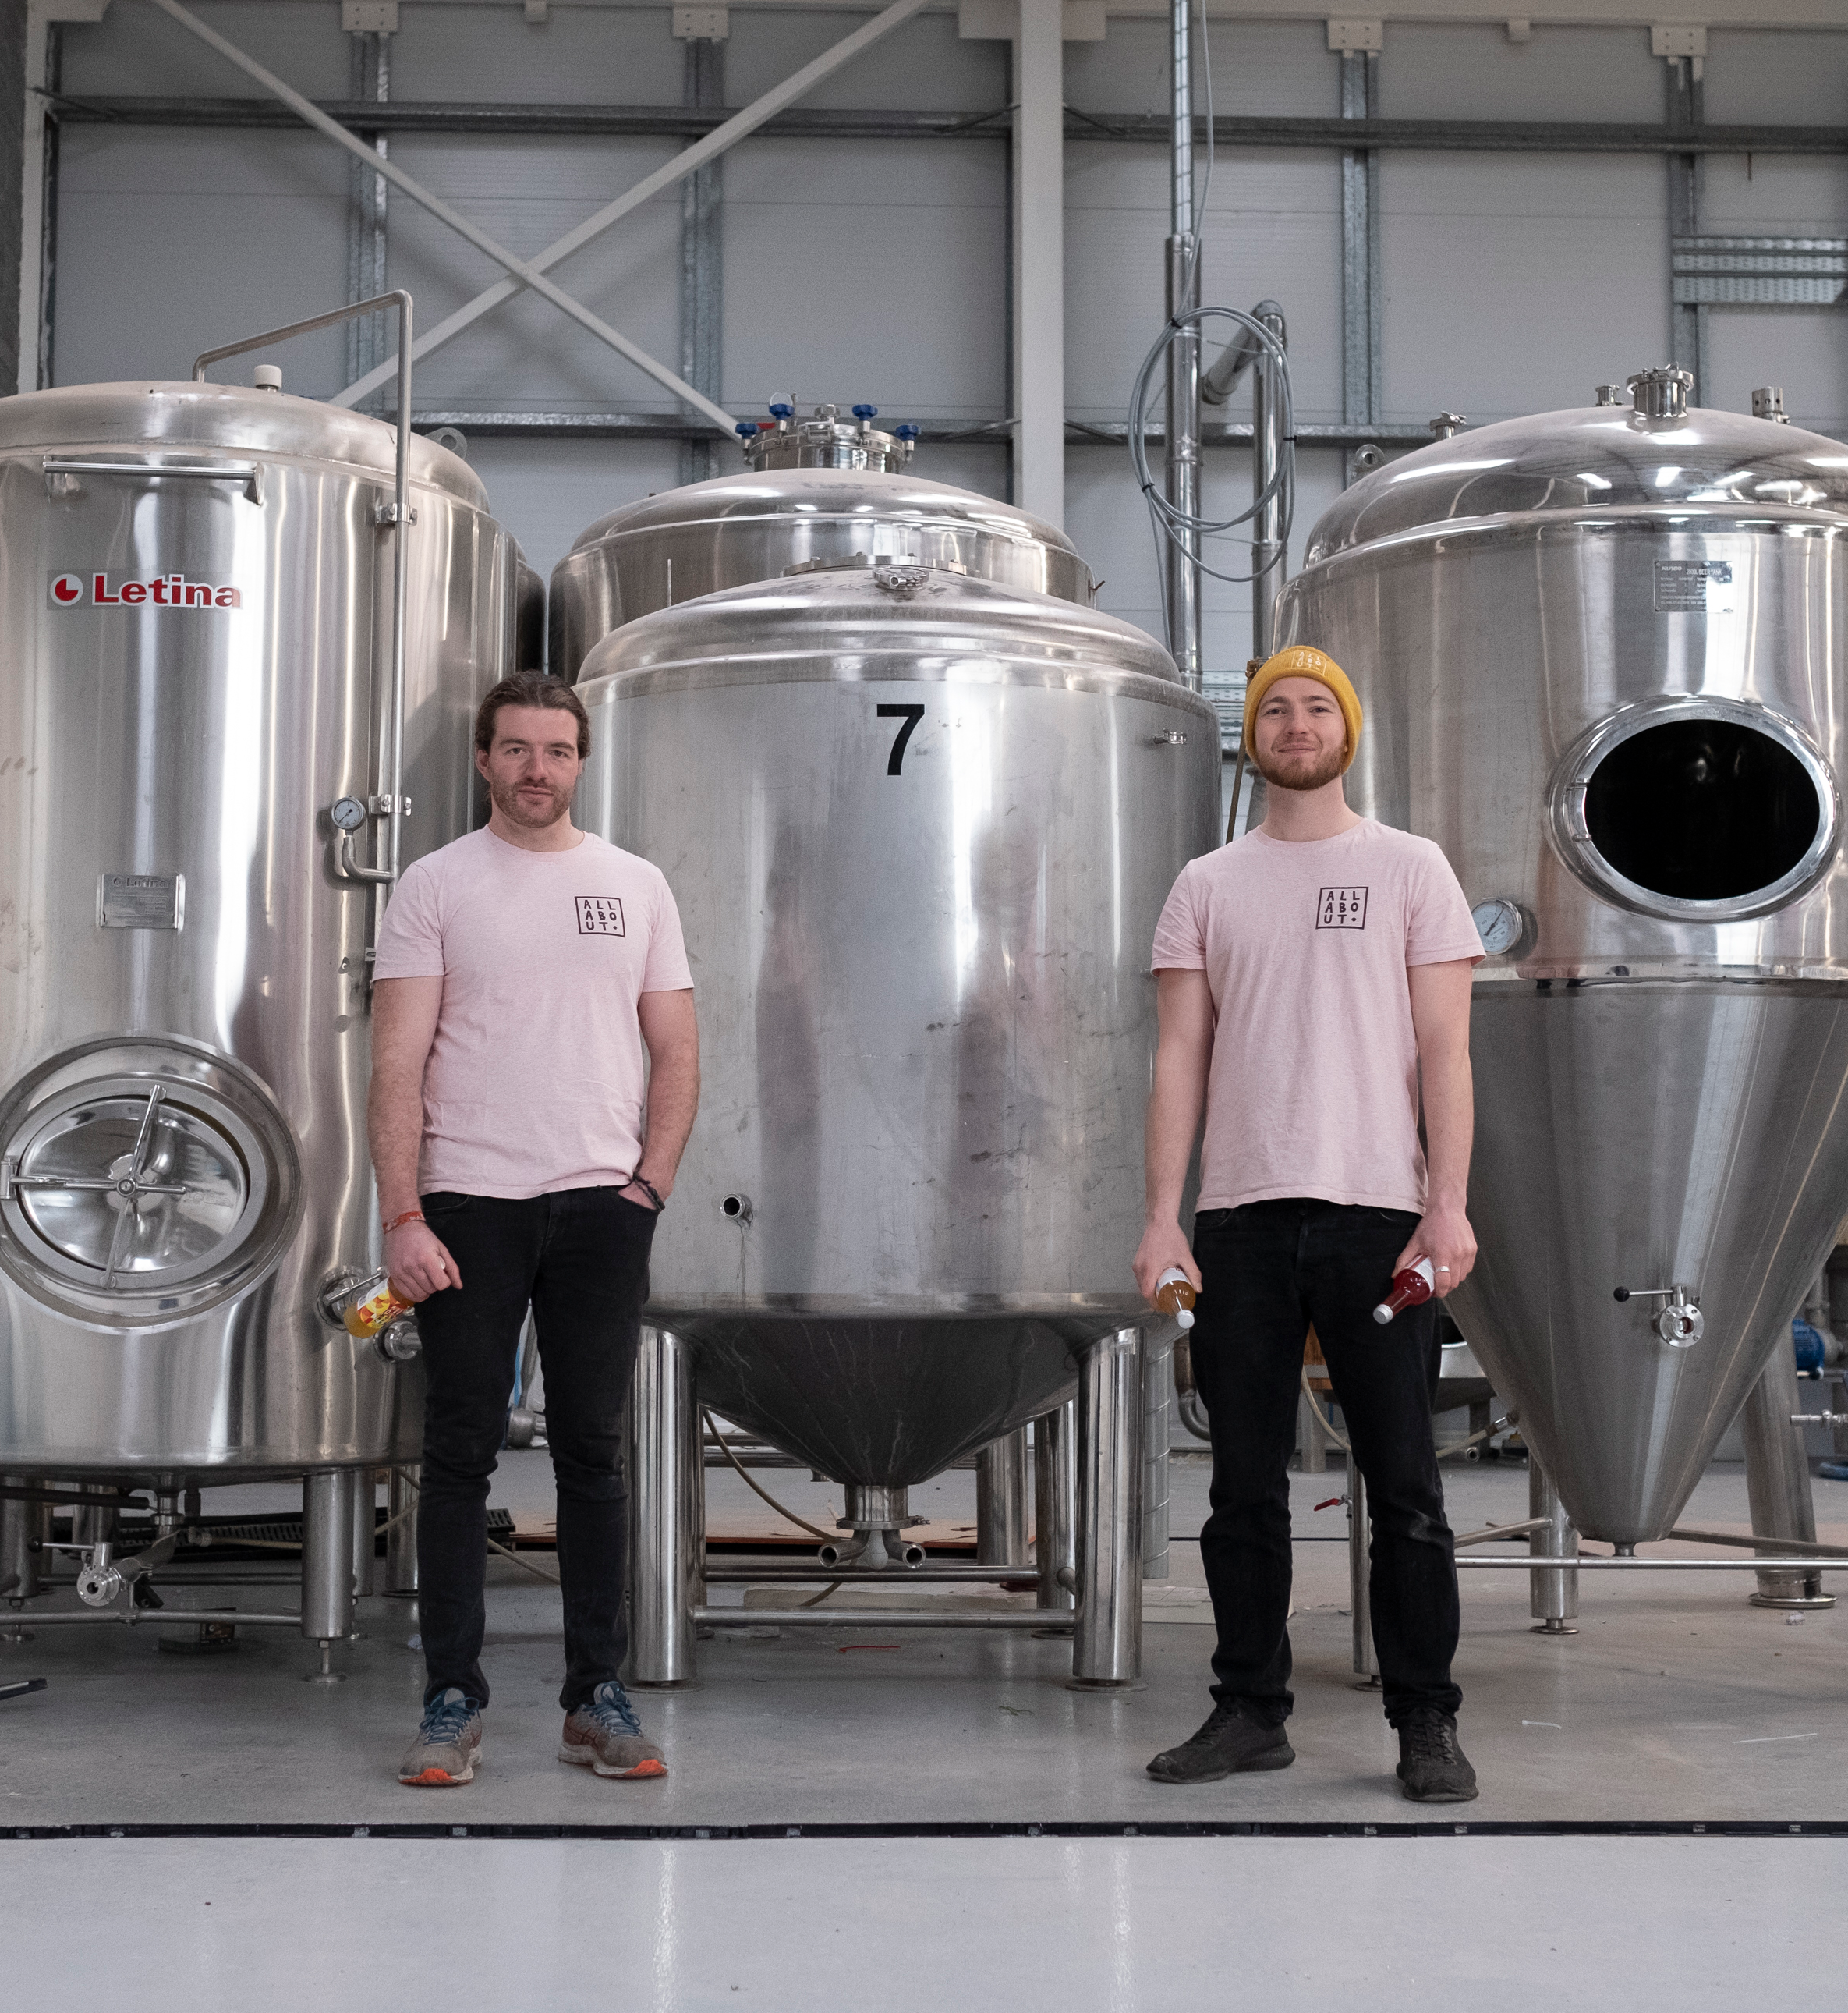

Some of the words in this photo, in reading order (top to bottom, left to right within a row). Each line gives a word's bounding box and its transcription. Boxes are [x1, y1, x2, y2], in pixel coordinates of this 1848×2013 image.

[93, 573, 243, 609] Letina
[876, 703, 926, 776] 7
[1326, 891, 1360, 901] ALL
[584, 899, 616, 910] ALL
[1325, 902, 1358, 913] ABO
[585, 910, 617, 921] ABO
